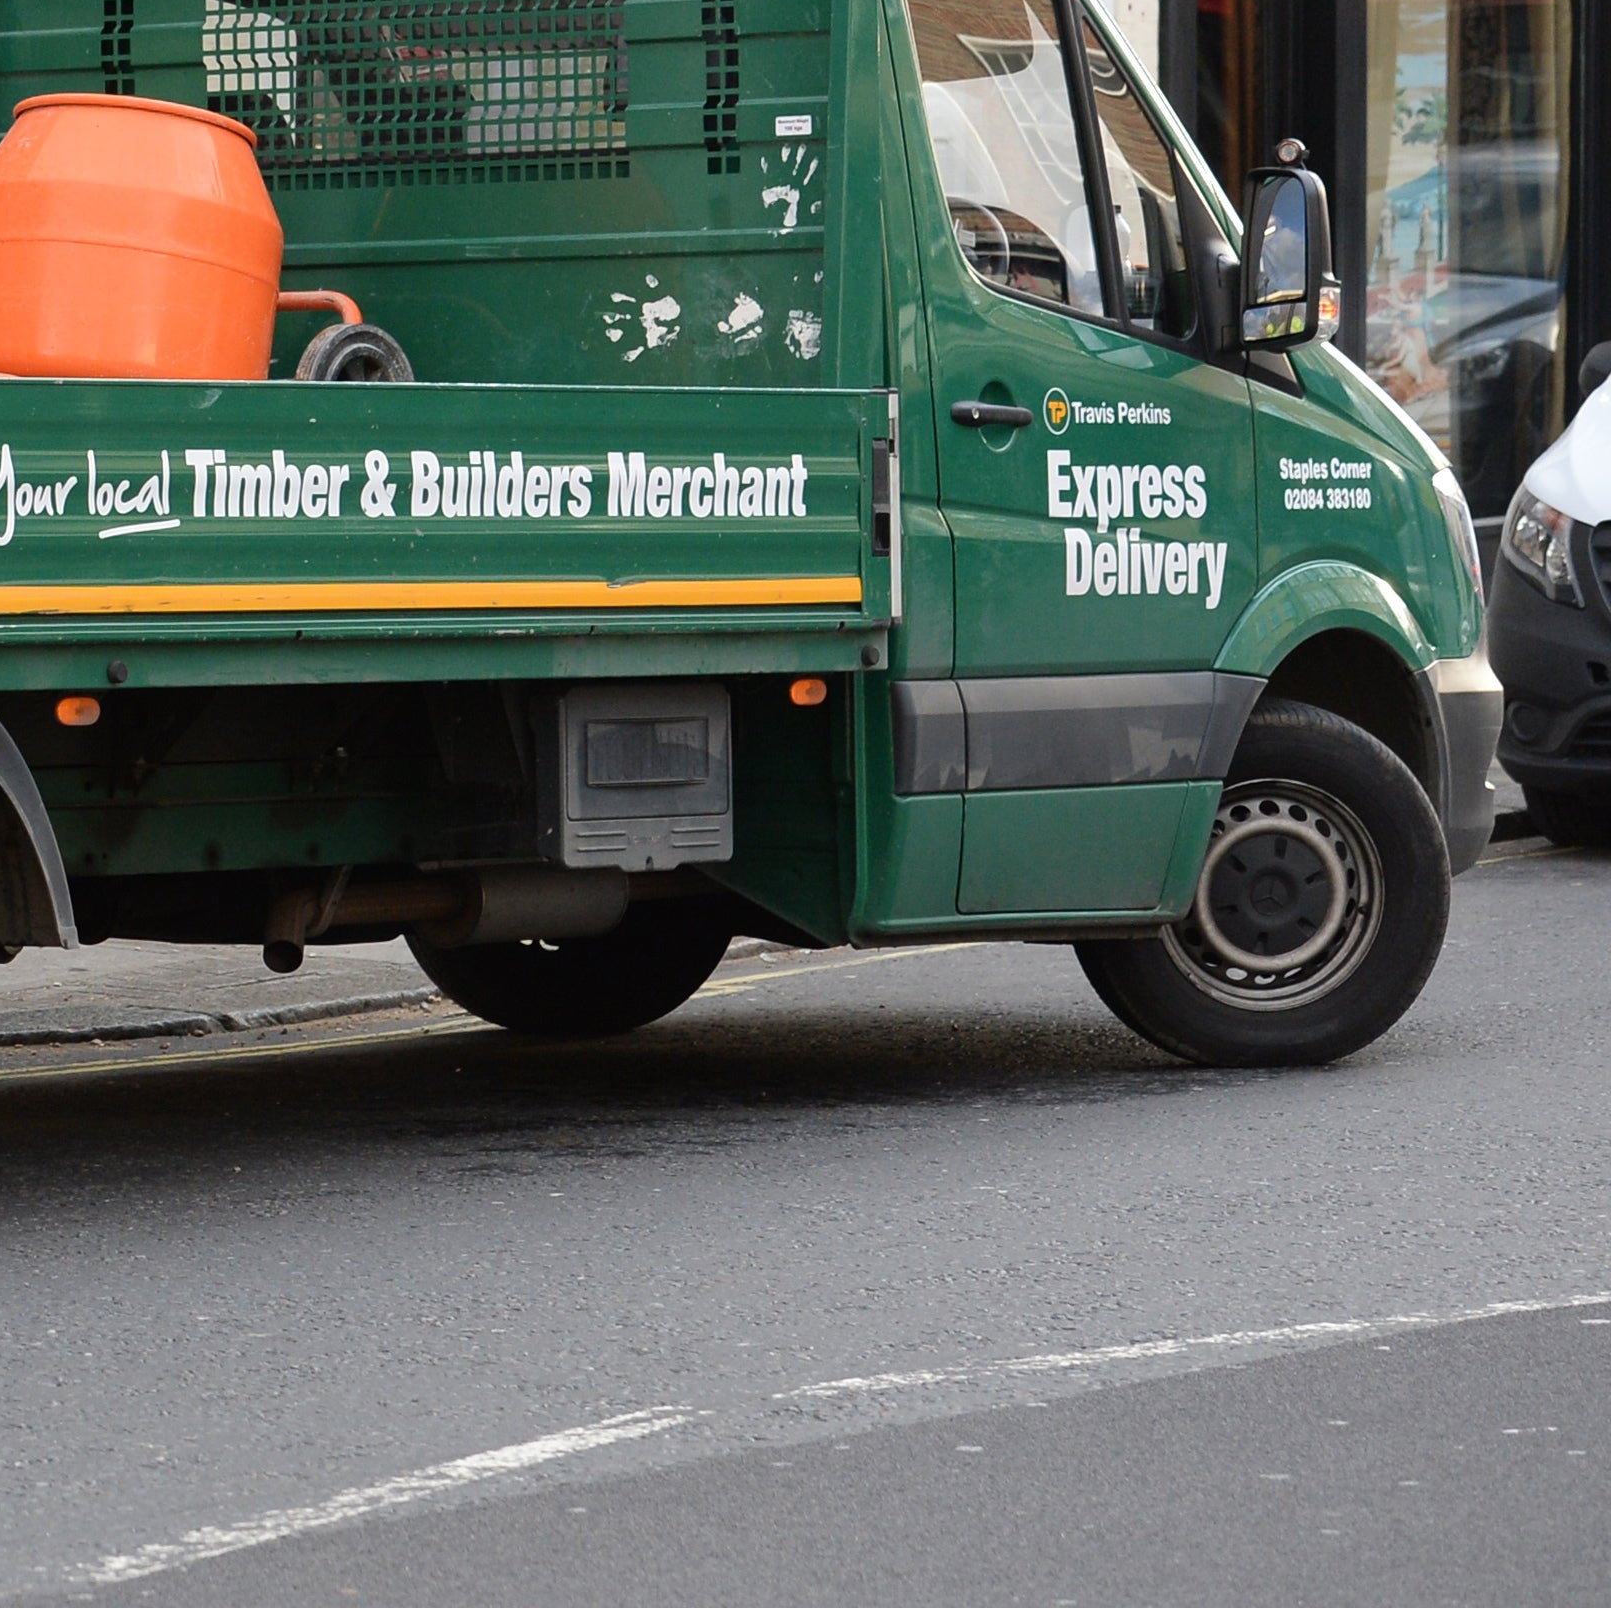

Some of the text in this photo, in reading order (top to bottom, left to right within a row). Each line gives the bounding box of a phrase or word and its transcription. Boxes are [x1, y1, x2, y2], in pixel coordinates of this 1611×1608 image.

[1048, 400, 1172, 426] TP Travis Perkins
[86, 449, 172, 518] local
[185, 448, 350, 519] Timber
[360, 448, 397, 519] &
[411, 449, 593, 519] Builders
[606, 451, 808, 519] Merchant
[1047, 449, 1207, 534] Express
[1280, 456, 1372, 486] Staples Corner
[1284, 487, 1372, 510] 02084 383180
[1064, 527, 1228, 610] Delivery
